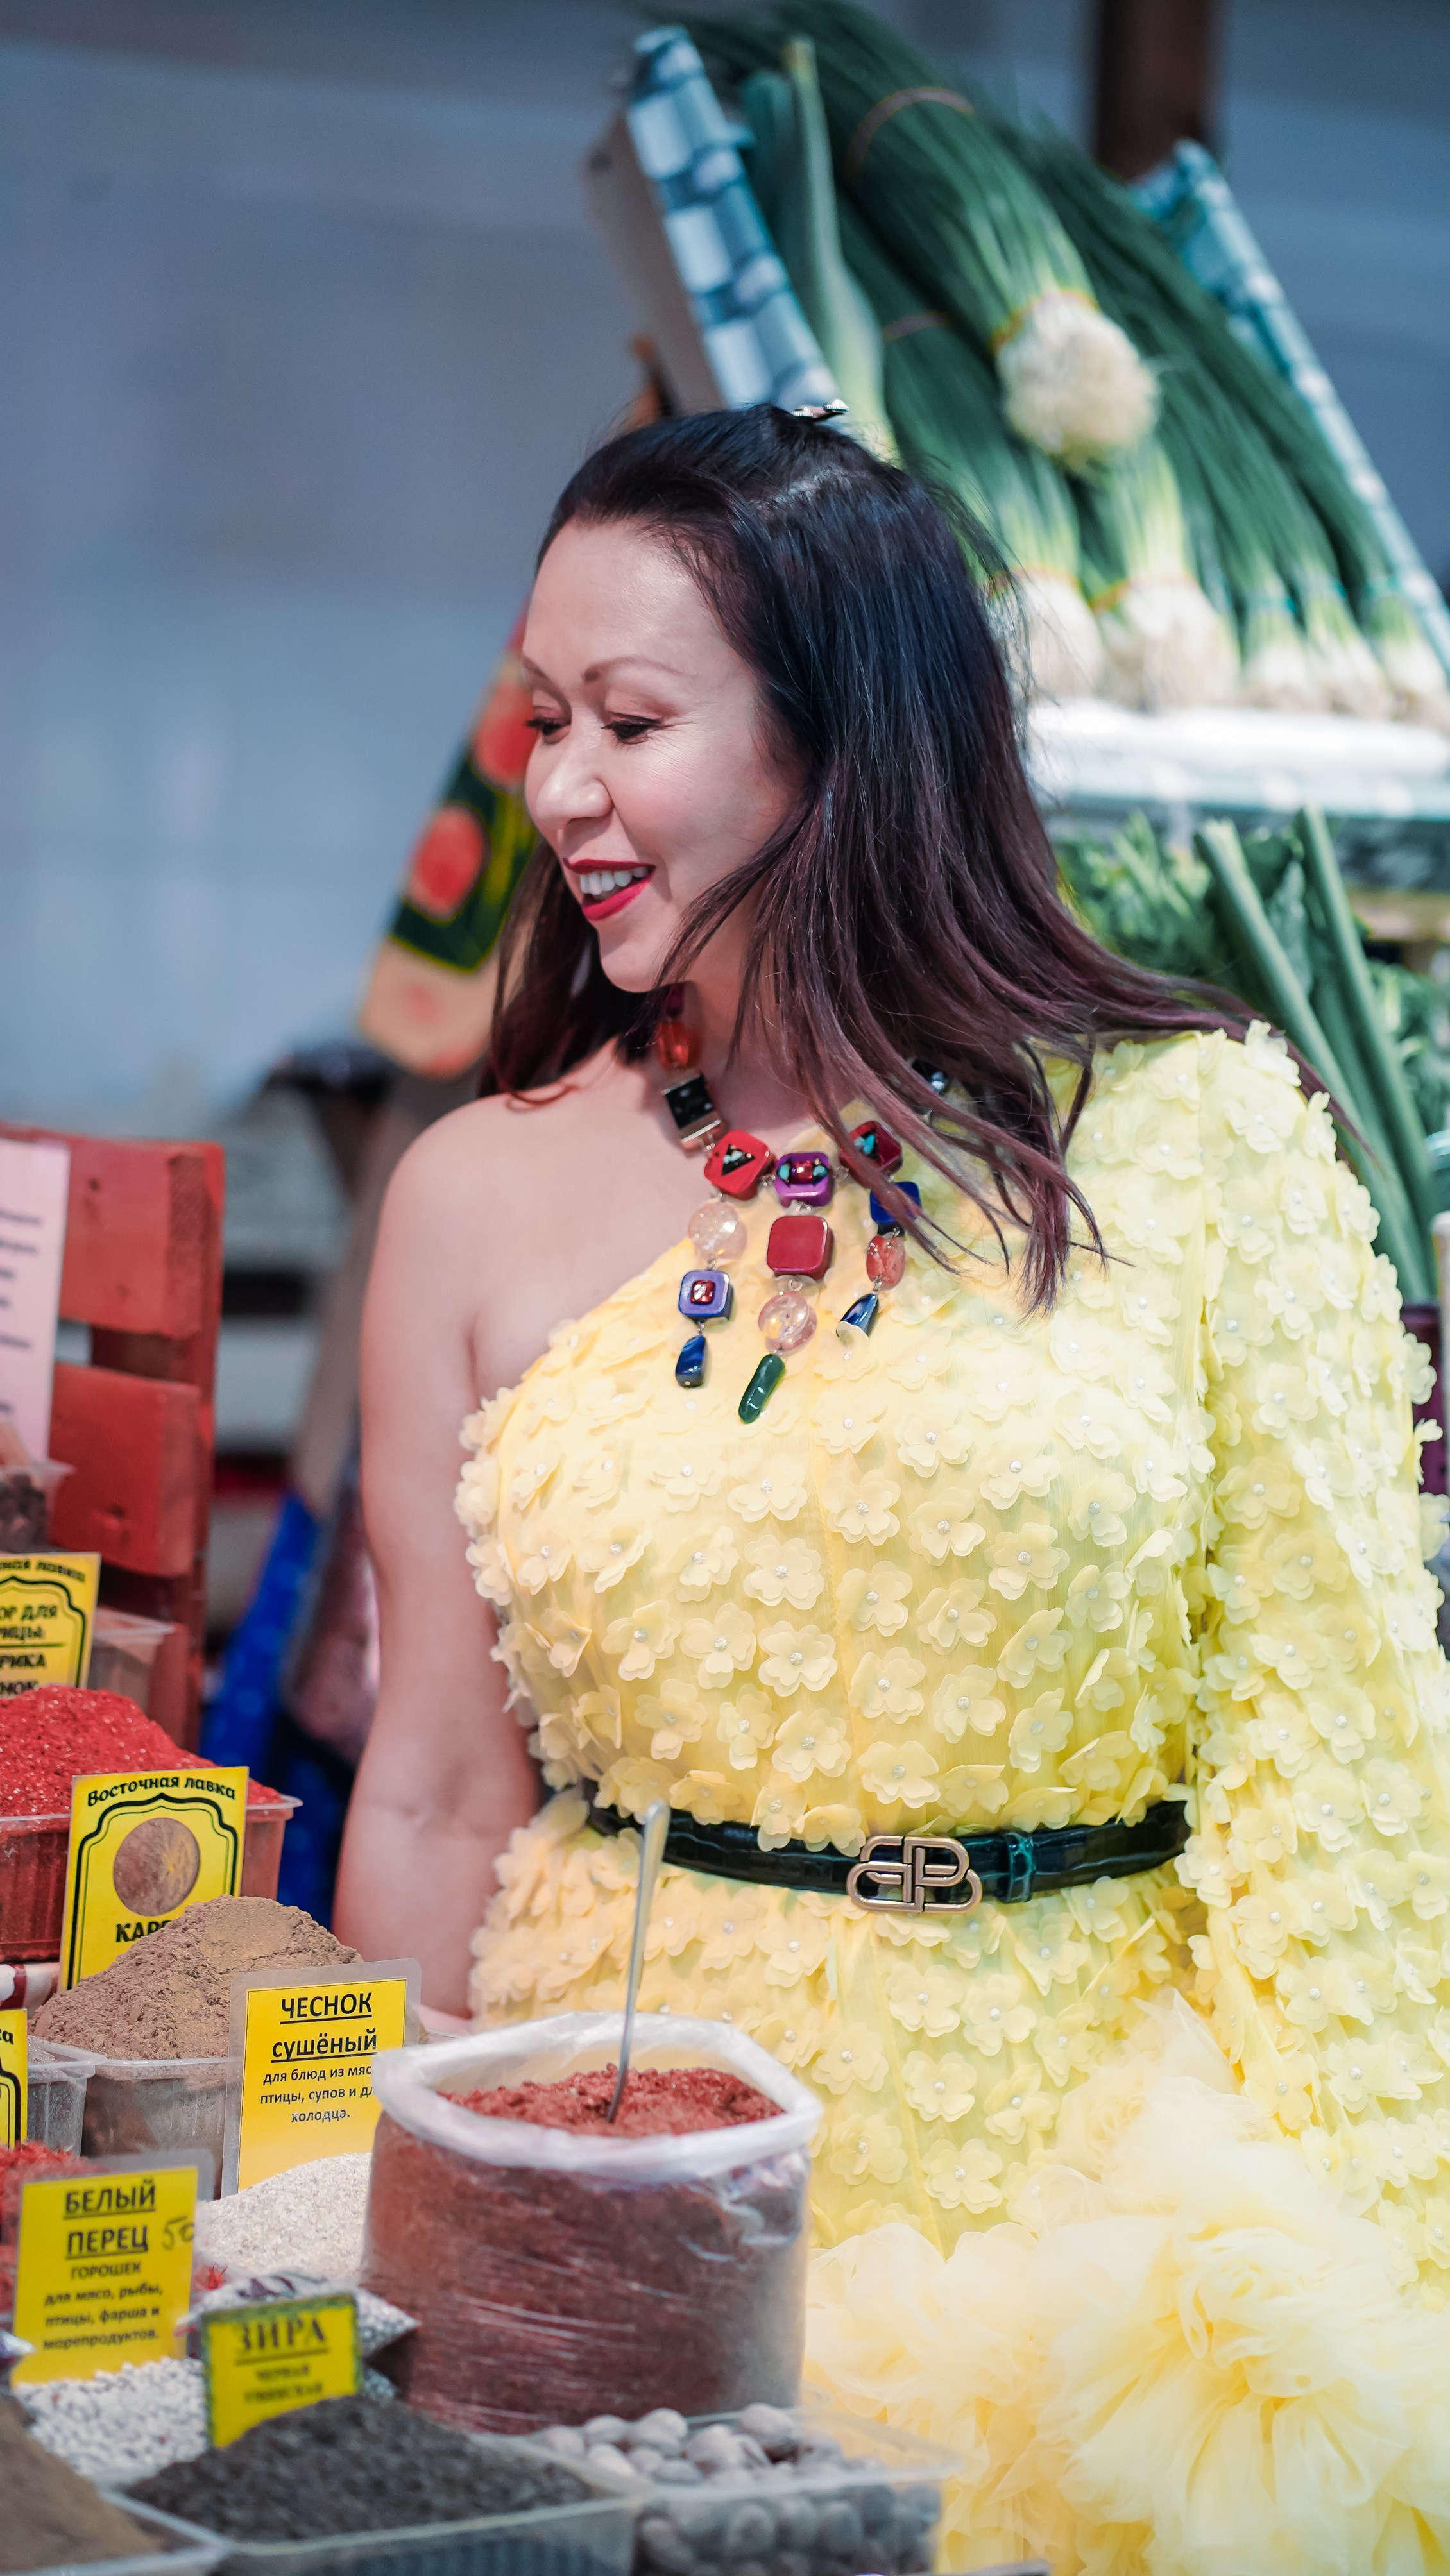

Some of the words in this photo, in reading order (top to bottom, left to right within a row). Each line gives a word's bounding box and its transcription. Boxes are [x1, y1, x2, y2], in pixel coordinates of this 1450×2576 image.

[21, 1605, 57, 1620] ДЛЯ
[88, 1777, 180, 1807] Восточная
[185, 1777, 235, 1800] лавка
[115, 1920, 172, 1943] КАР
[281, 1992, 373, 2019] ЧЕСНОК
[272, 2028, 377, 2060] сушёный
[263, 2072, 287, 2086] для
[291, 2068, 327, 2081] блюд
[330, 2067, 345, 2078] из
[348, 2065, 372, 2077] мяс
[260, 2092, 305, 2105] птицы,
[308, 2089, 345, 2103] супов
[348, 2087, 357, 2097] и
[291, 2109, 350, 2123] холодца.
[65, 2178, 155, 2214] БЕЛЫЙ
[67, 2225, 148, 2253] ПЕРЕЦ
[71, 2262, 142, 2280] ГОРОШЕК
[45, 2292, 71, 2307] для
[119, 2282, 162, 2300] рыбы,
[99, 2307, 147, 2323] фарша
[151, 2307, 160, 2316] и
[43, 2329, 158, 2351] морепродуктов.
[243, 2317, 325, 2351] ЗИРА
